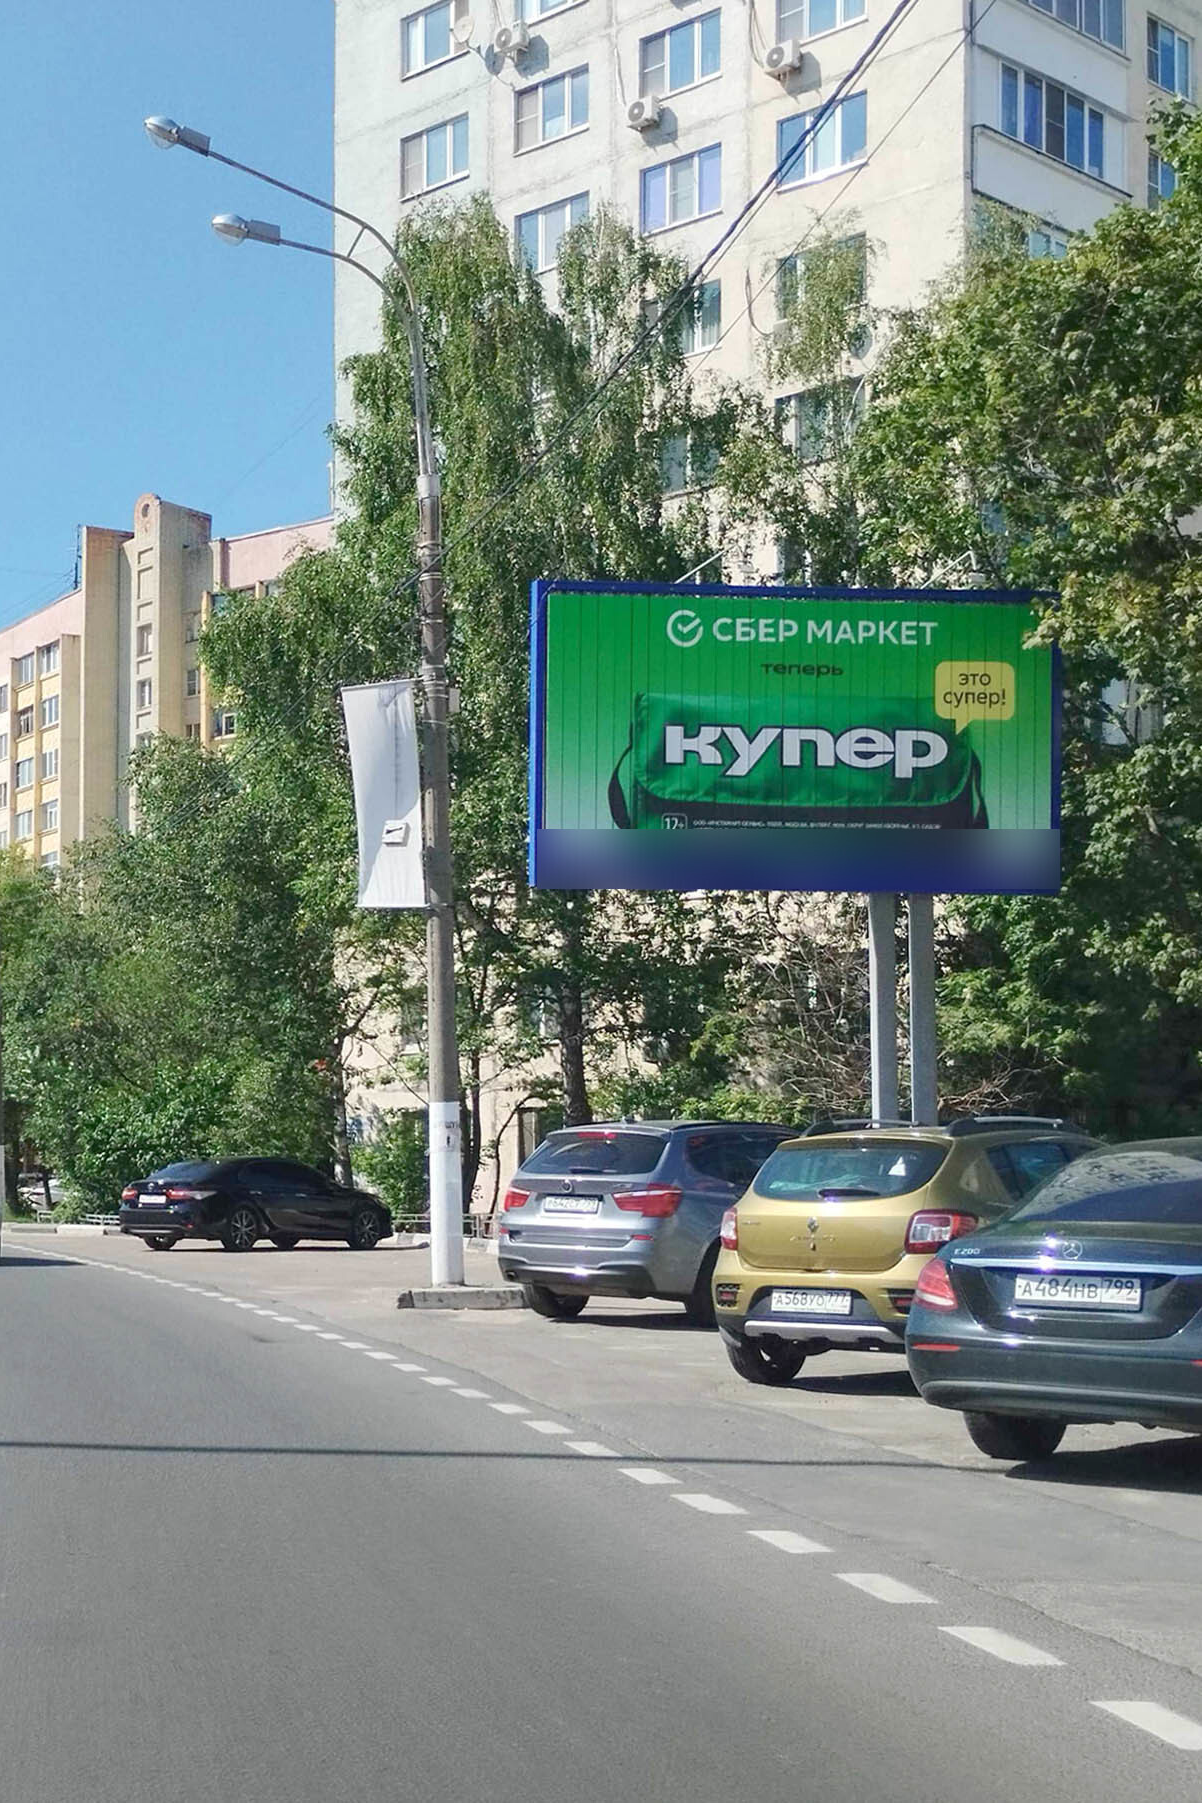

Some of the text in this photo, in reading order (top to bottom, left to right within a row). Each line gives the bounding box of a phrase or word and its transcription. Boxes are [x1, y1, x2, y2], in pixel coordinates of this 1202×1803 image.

[712, 617, 938, 646] СБЕР МАРКЕТ
[760, 662, 844, 678] теперь
[958, 672, 992, 687] это
[942, 689, 1007, 707] супер!
[664, 725, 948, 779] купер
